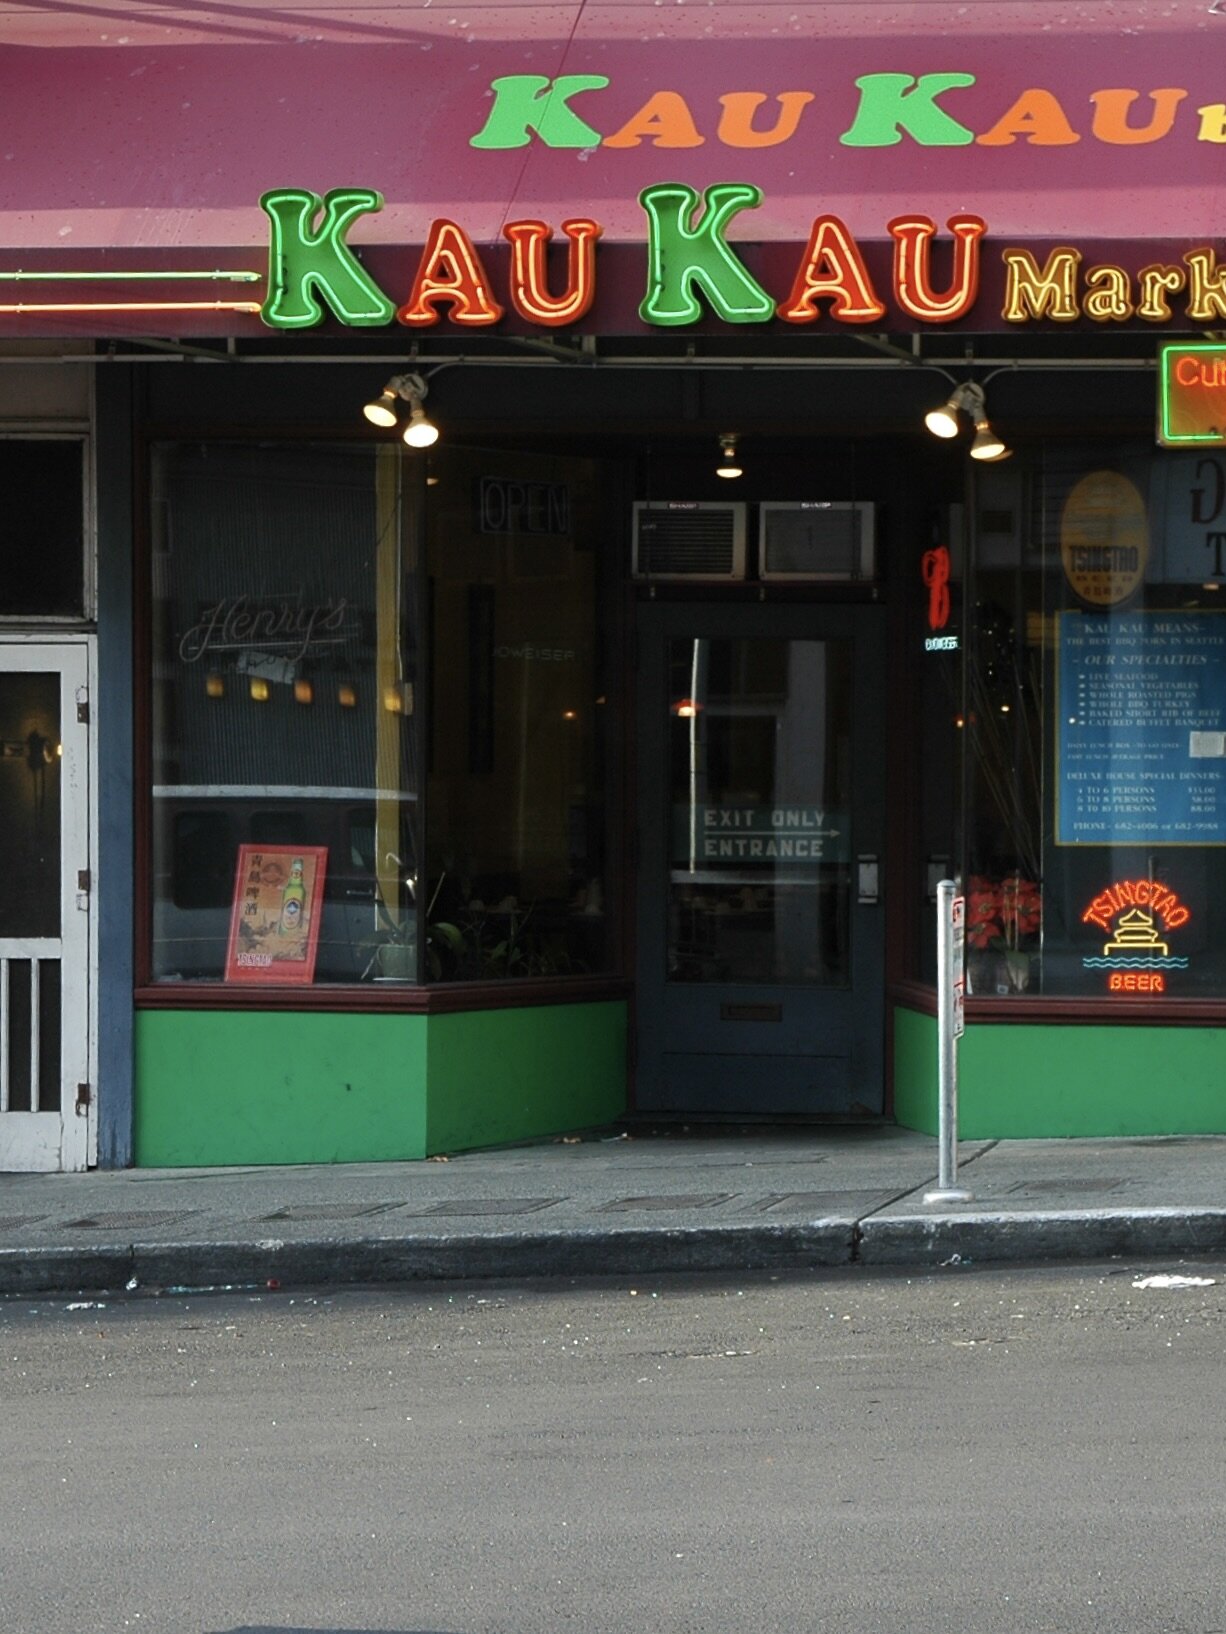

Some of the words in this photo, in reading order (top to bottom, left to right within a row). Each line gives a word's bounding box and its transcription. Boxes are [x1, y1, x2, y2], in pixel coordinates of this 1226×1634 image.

[469, 75, 815, 149] KAU
[840, 73, 1187, 147] KAU
[260, 187, 603, 328] KAU
[638, 183, 989, 325] KAU
[484, 483, 569, 534] OPEN
[180, 594, 347, 663] Henry's
[1084, 654, 1117, 665] OUR
[1121, 654, 1208, 665] SPECIALTIES
[704, 809, 755, 828] EXIT
[771, 809, 826, 827] ONLY
[704, 838, 824, 858] ENTRANCE
[1082, 880, 1190, 930] TSINGTAO
[1109, 972, 1165, 993] BEER
